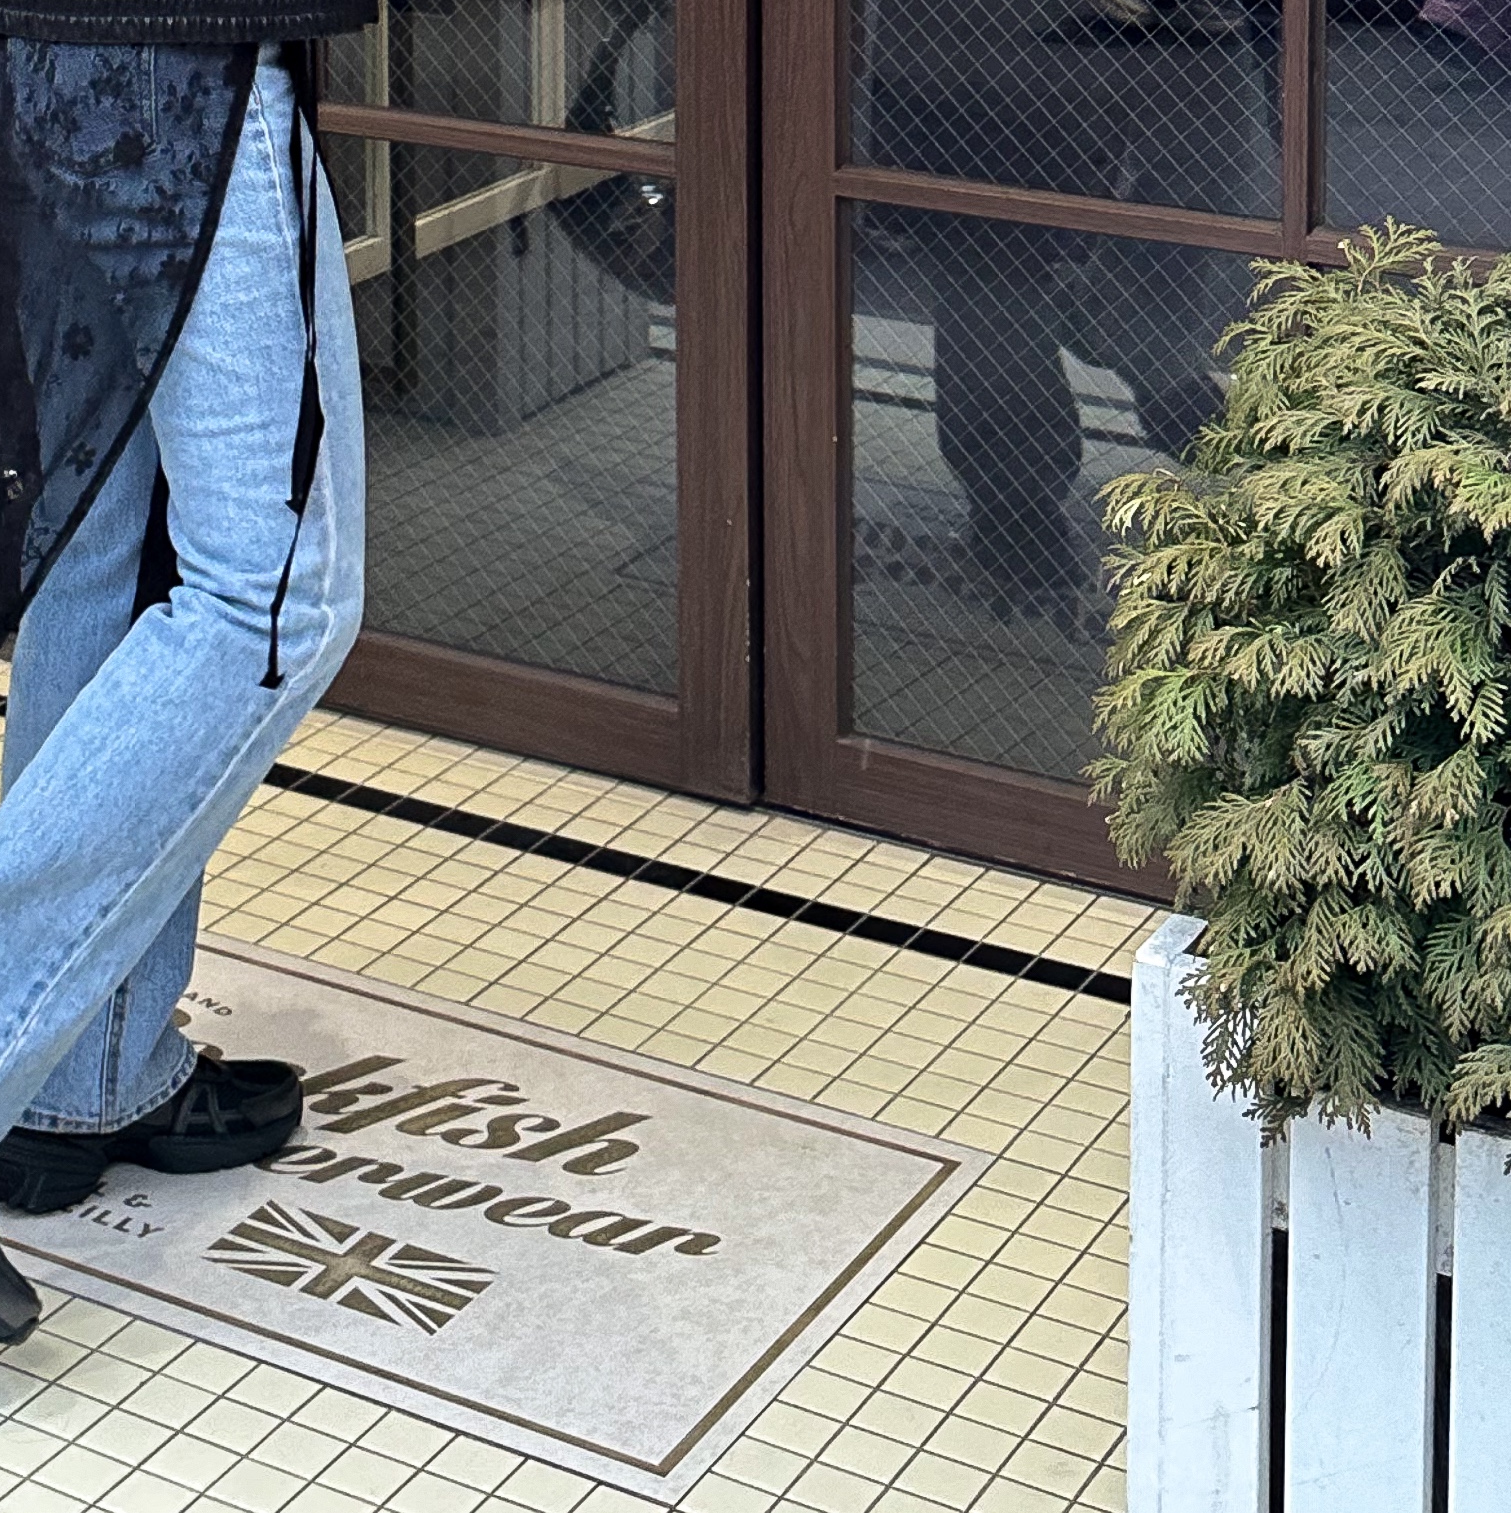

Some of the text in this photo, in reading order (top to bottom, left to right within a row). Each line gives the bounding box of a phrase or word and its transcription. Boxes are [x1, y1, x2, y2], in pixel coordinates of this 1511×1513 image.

[186, 991, 233, 1016] AND
[298, 1054, 651, 1176] kfish
[73, 1204, 165, 1238] ILLY
[254, 1144, 723, 1257] erwear
